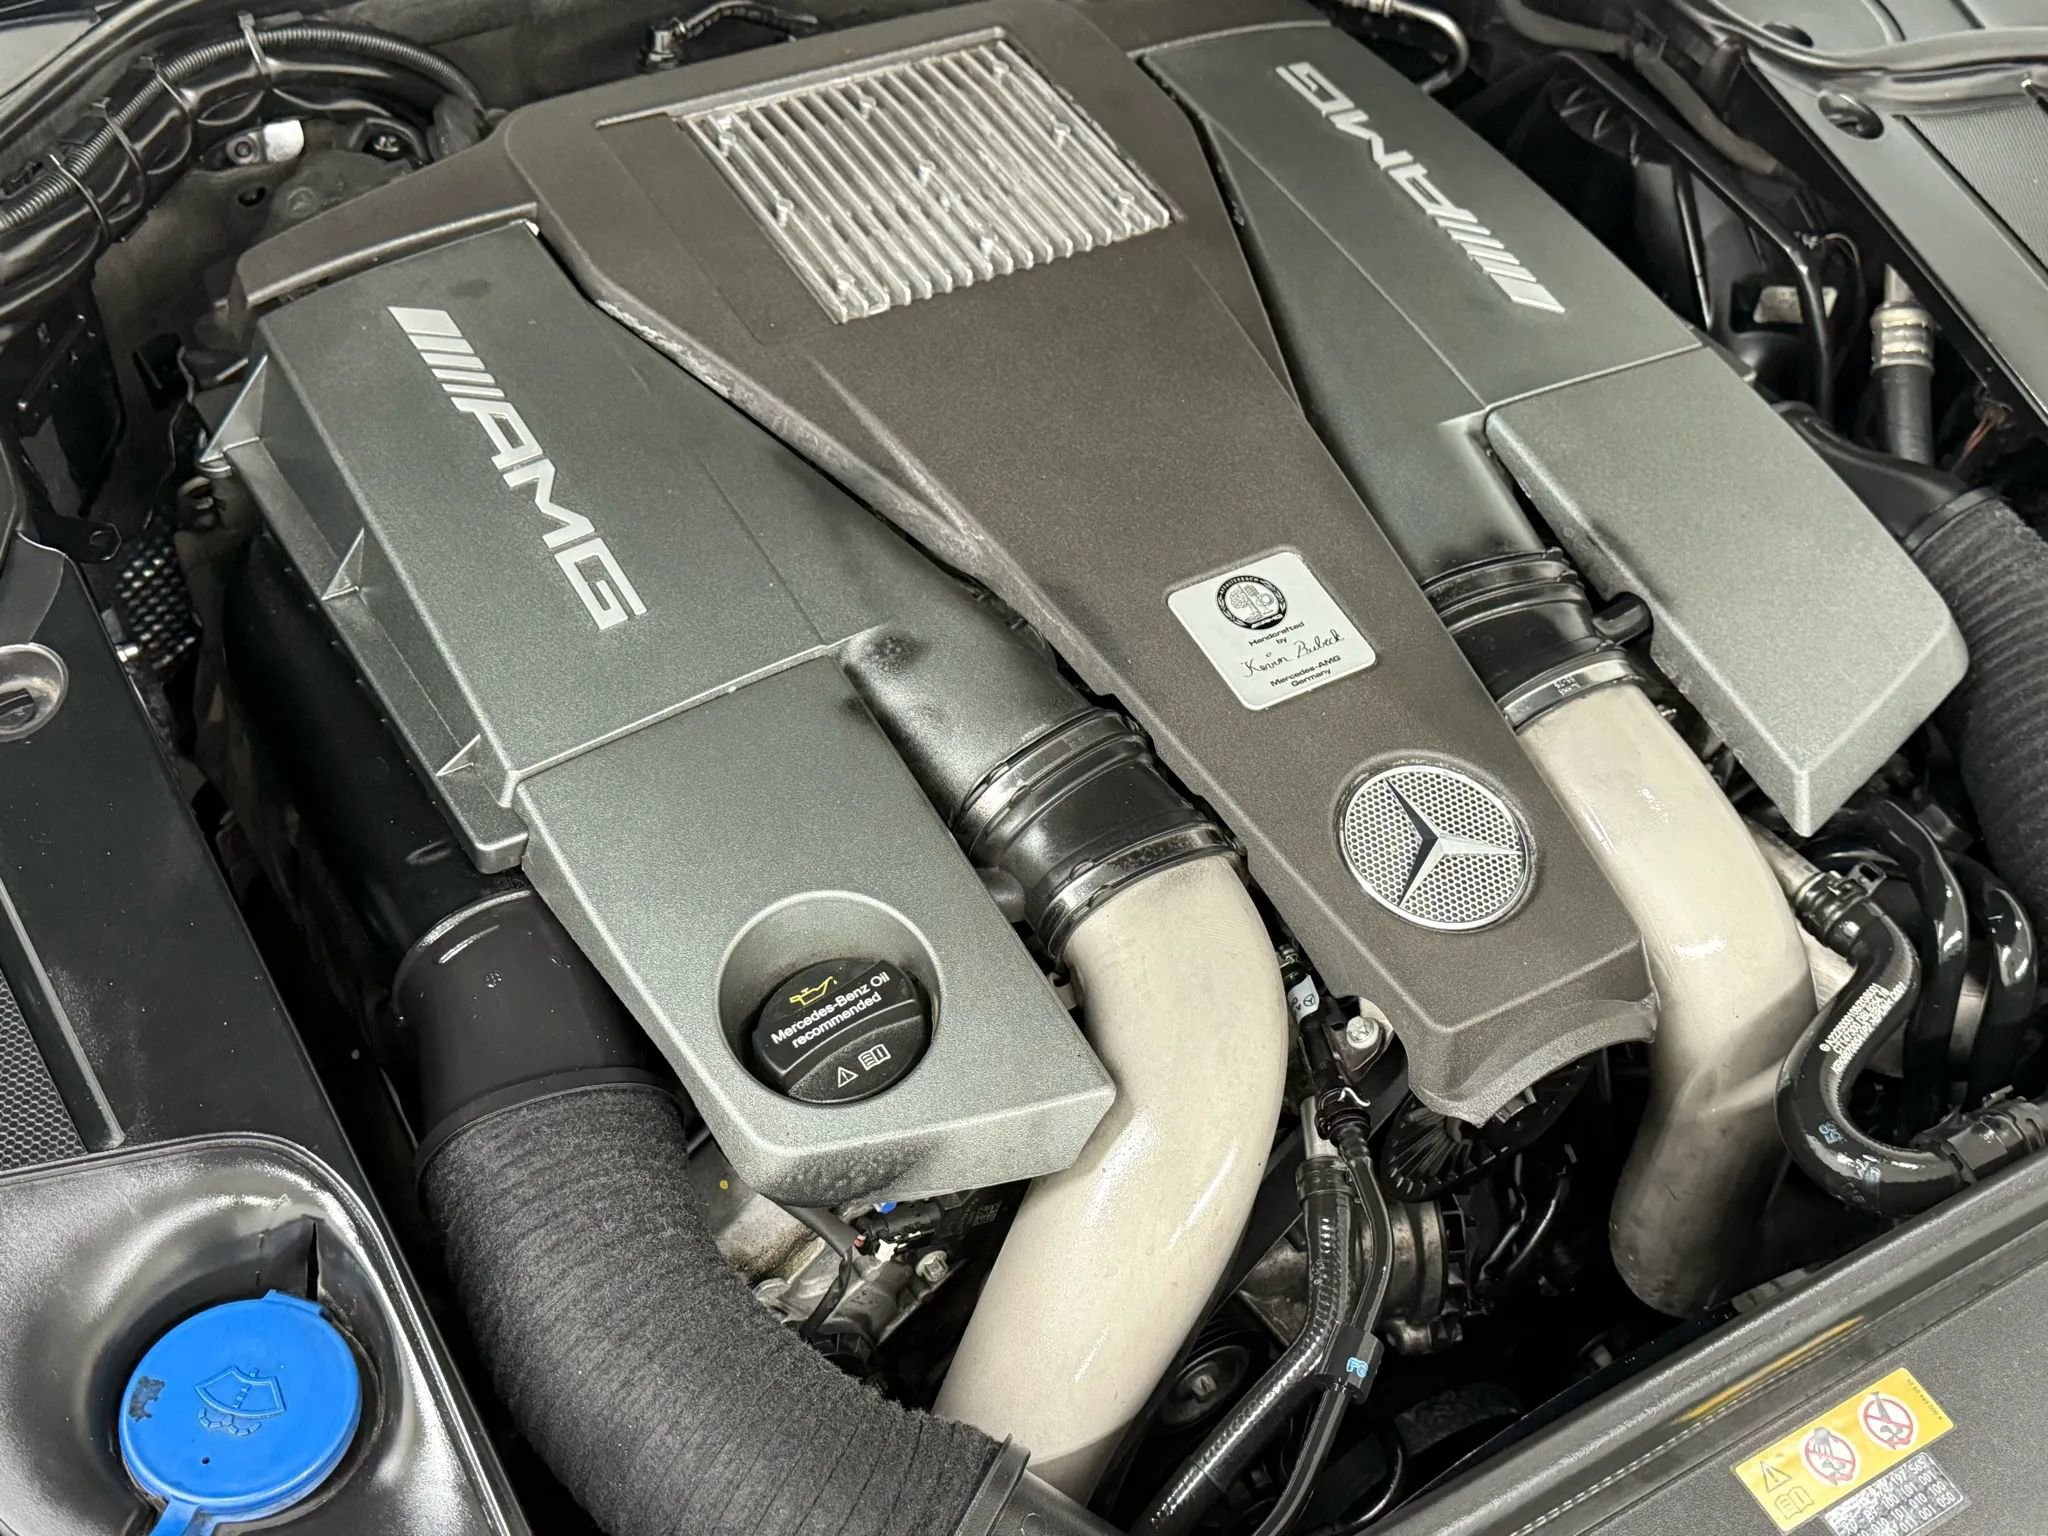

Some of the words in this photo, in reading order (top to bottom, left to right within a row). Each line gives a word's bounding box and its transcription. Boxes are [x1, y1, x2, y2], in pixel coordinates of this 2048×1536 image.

[450, 396, 648, 631] AMG
[1248, 621, 1305, 647] Handcrafted
[1275, 636, 1288, 645] by
[1270, 654, 1342, 687] Mercedes-AMG
[1290, 669, 1332, 688] Germany
[770, 983, 871, 1045] Mercedes-Benz
[869, 971, 891, 988] Oil
[791, 990, 883, 1049] recommended
